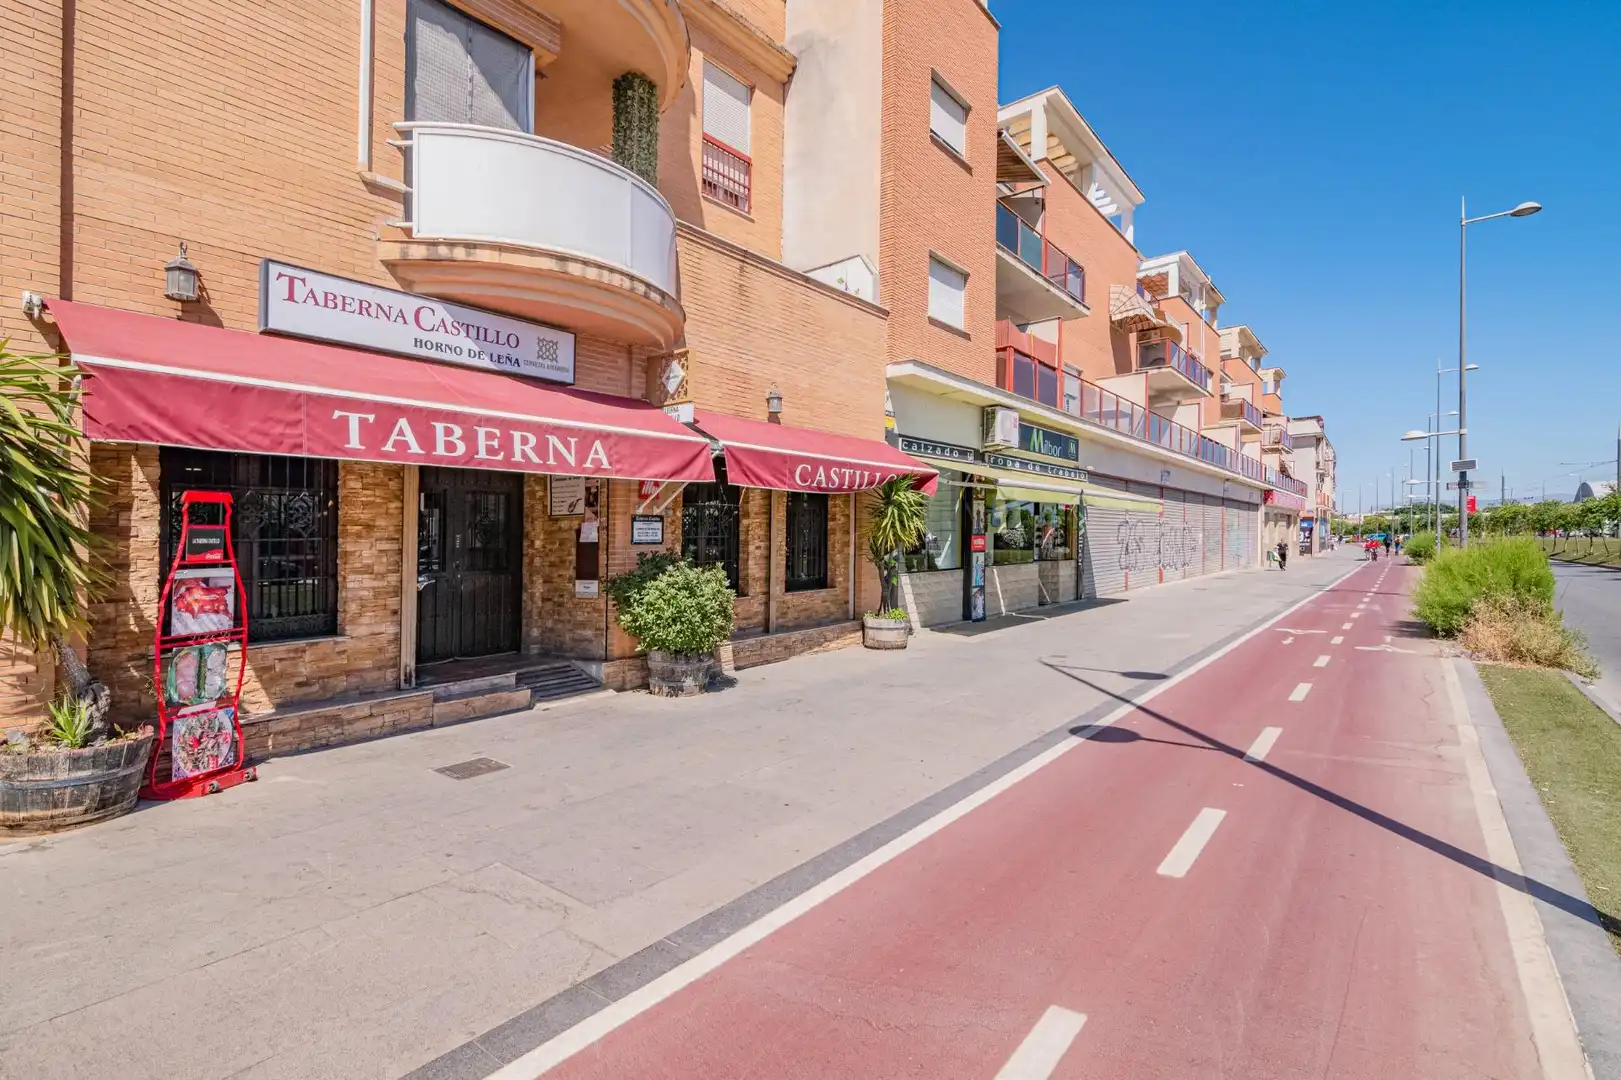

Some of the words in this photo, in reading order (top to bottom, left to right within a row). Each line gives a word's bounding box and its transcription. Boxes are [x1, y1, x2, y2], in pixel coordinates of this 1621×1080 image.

[276, 272, 408, 325] TABERNA
[414, 305, 520, 349] CASTILLO
[414, 337, 463, 356] HORNO
[467, 349, 486, 361] DE
[490, 352, 521, 368] LEÑA
[332, 409, 612, 469] TABERNA
[902, 440, 959, 457] calzado
[990, 457, 1020, 469] ropa
[1028, 461, 1040, 471] de
[1047, 465, 1085, 479] trabajo
